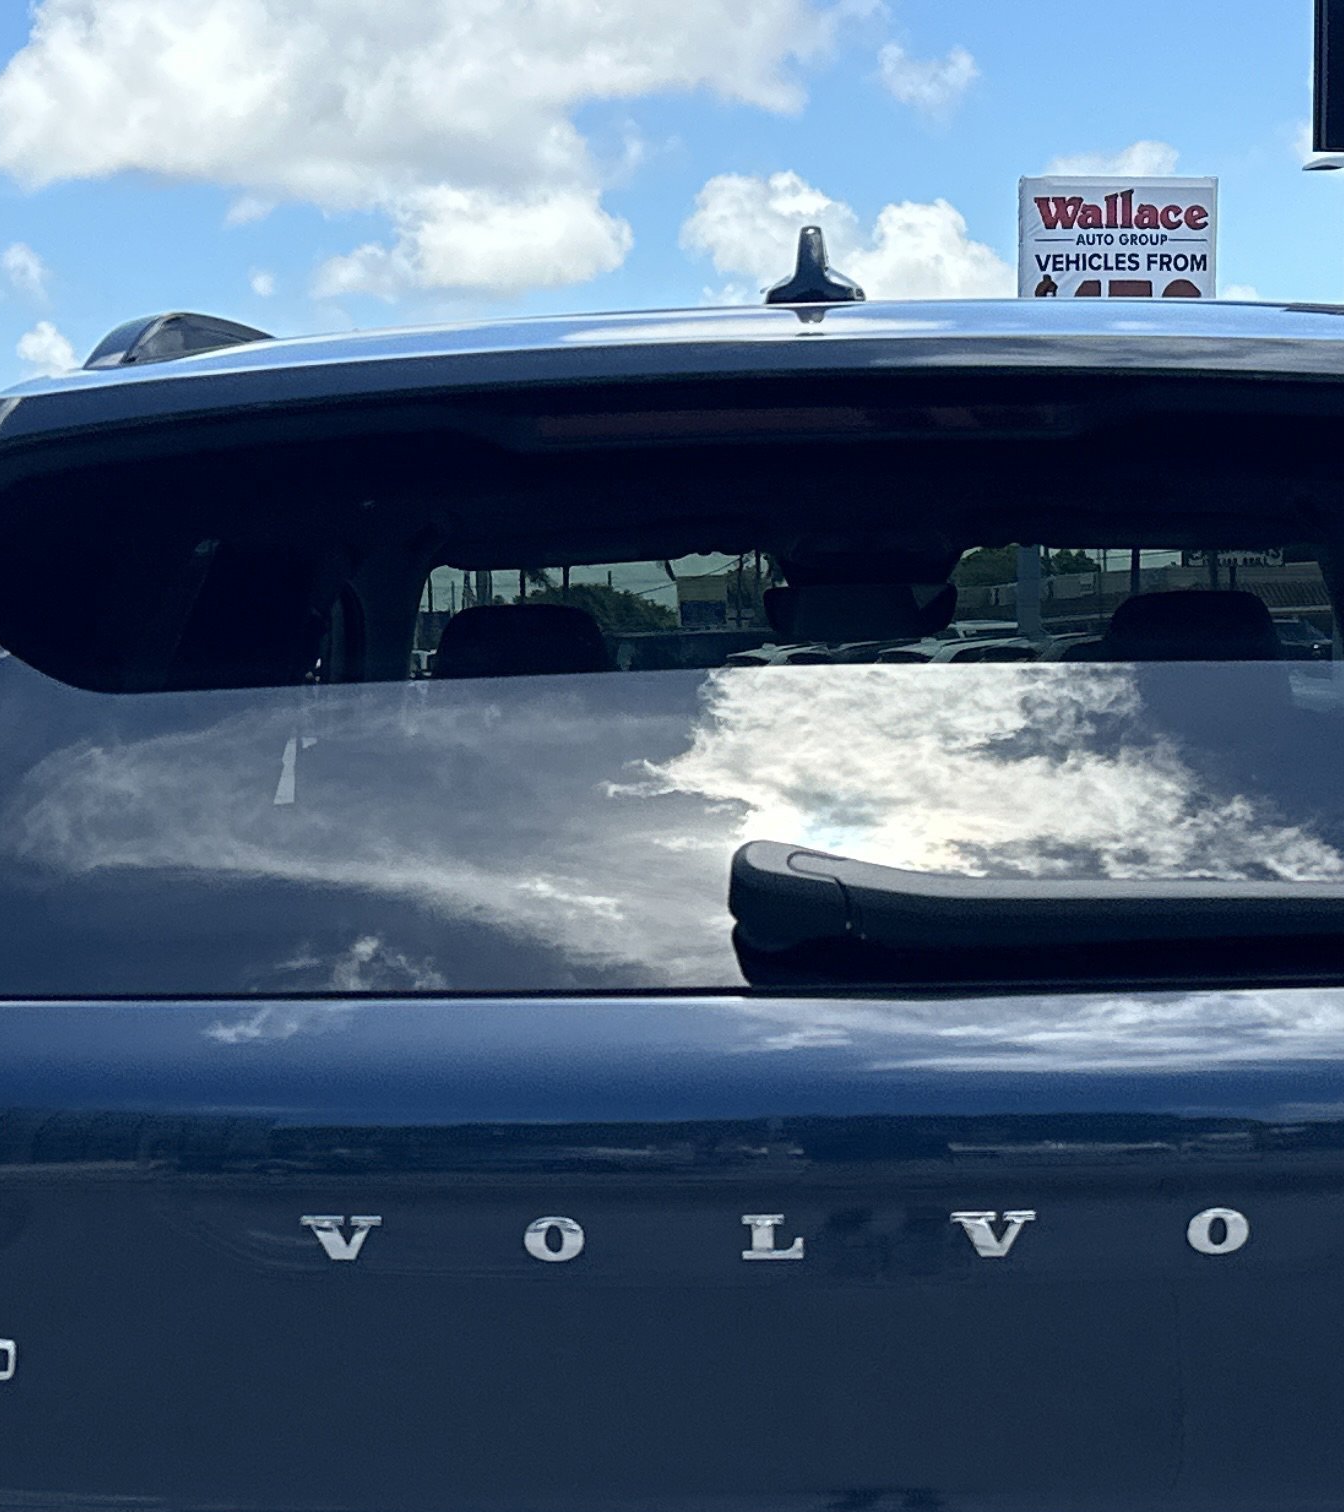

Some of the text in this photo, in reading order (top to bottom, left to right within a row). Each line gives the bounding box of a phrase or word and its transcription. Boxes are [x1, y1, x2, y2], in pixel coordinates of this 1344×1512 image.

[1034, 189, 1209, 230] Wallace
[1076, 234, 1168, 246] AUTO GROUP
[1035, 253, 1207, 272] VEHICLES FROM
[301, 1207, 1250, 1264] VOLVO
